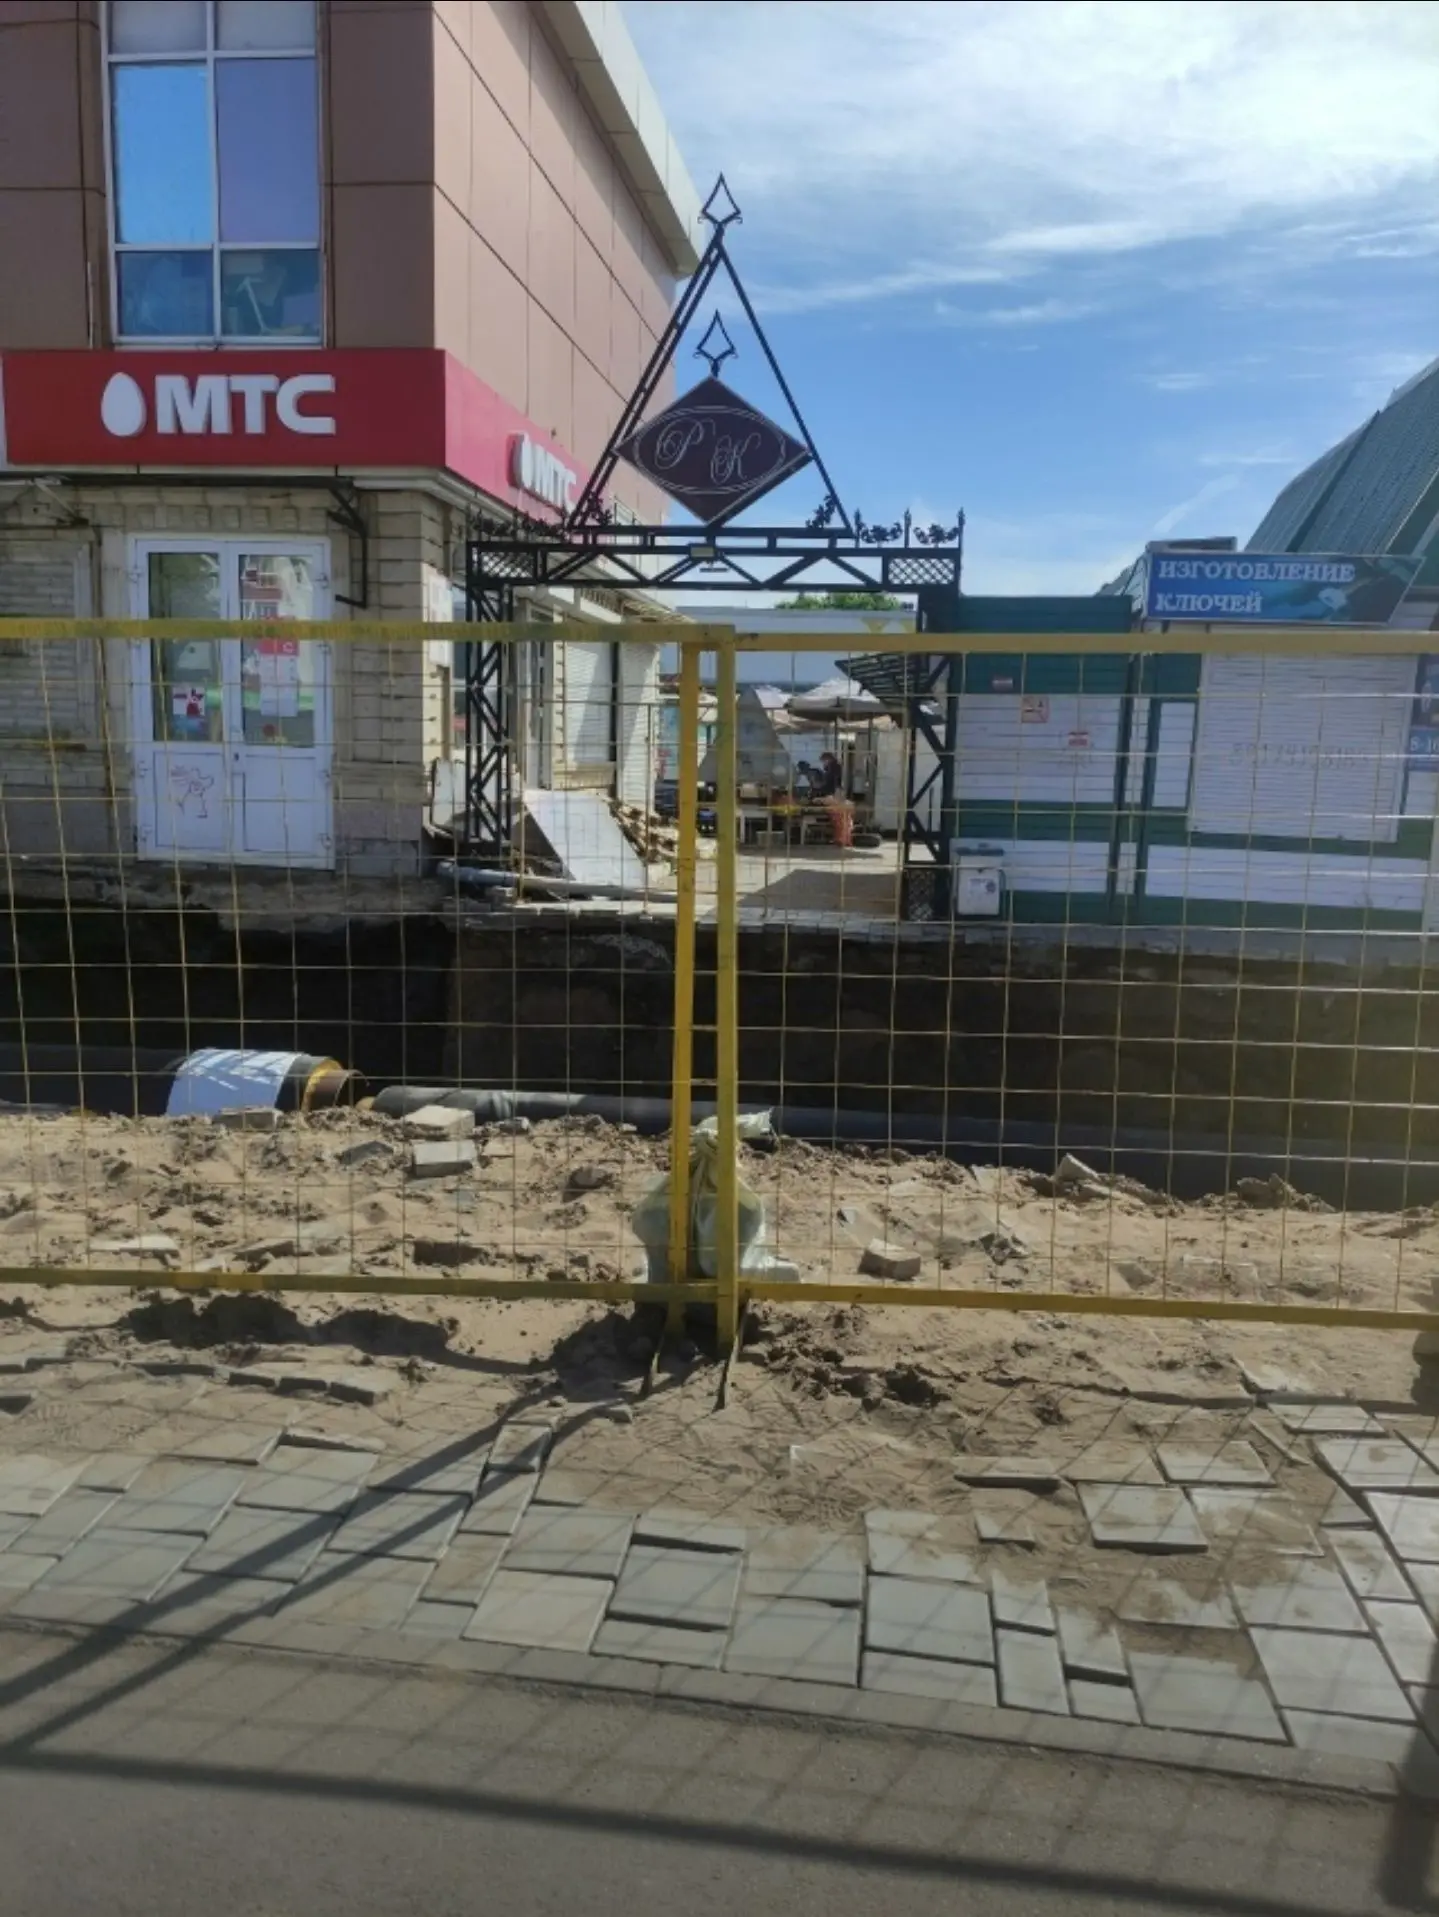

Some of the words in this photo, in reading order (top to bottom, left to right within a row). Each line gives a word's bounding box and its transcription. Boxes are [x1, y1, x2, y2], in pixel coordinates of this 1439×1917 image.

[154, 374, 336, 435] МТС
[1158, 560, 1356, 583] ИЗГОТОВЛЕНИЕ
[1154, 590, 1263, 614] КЛЮЧЕЙ
